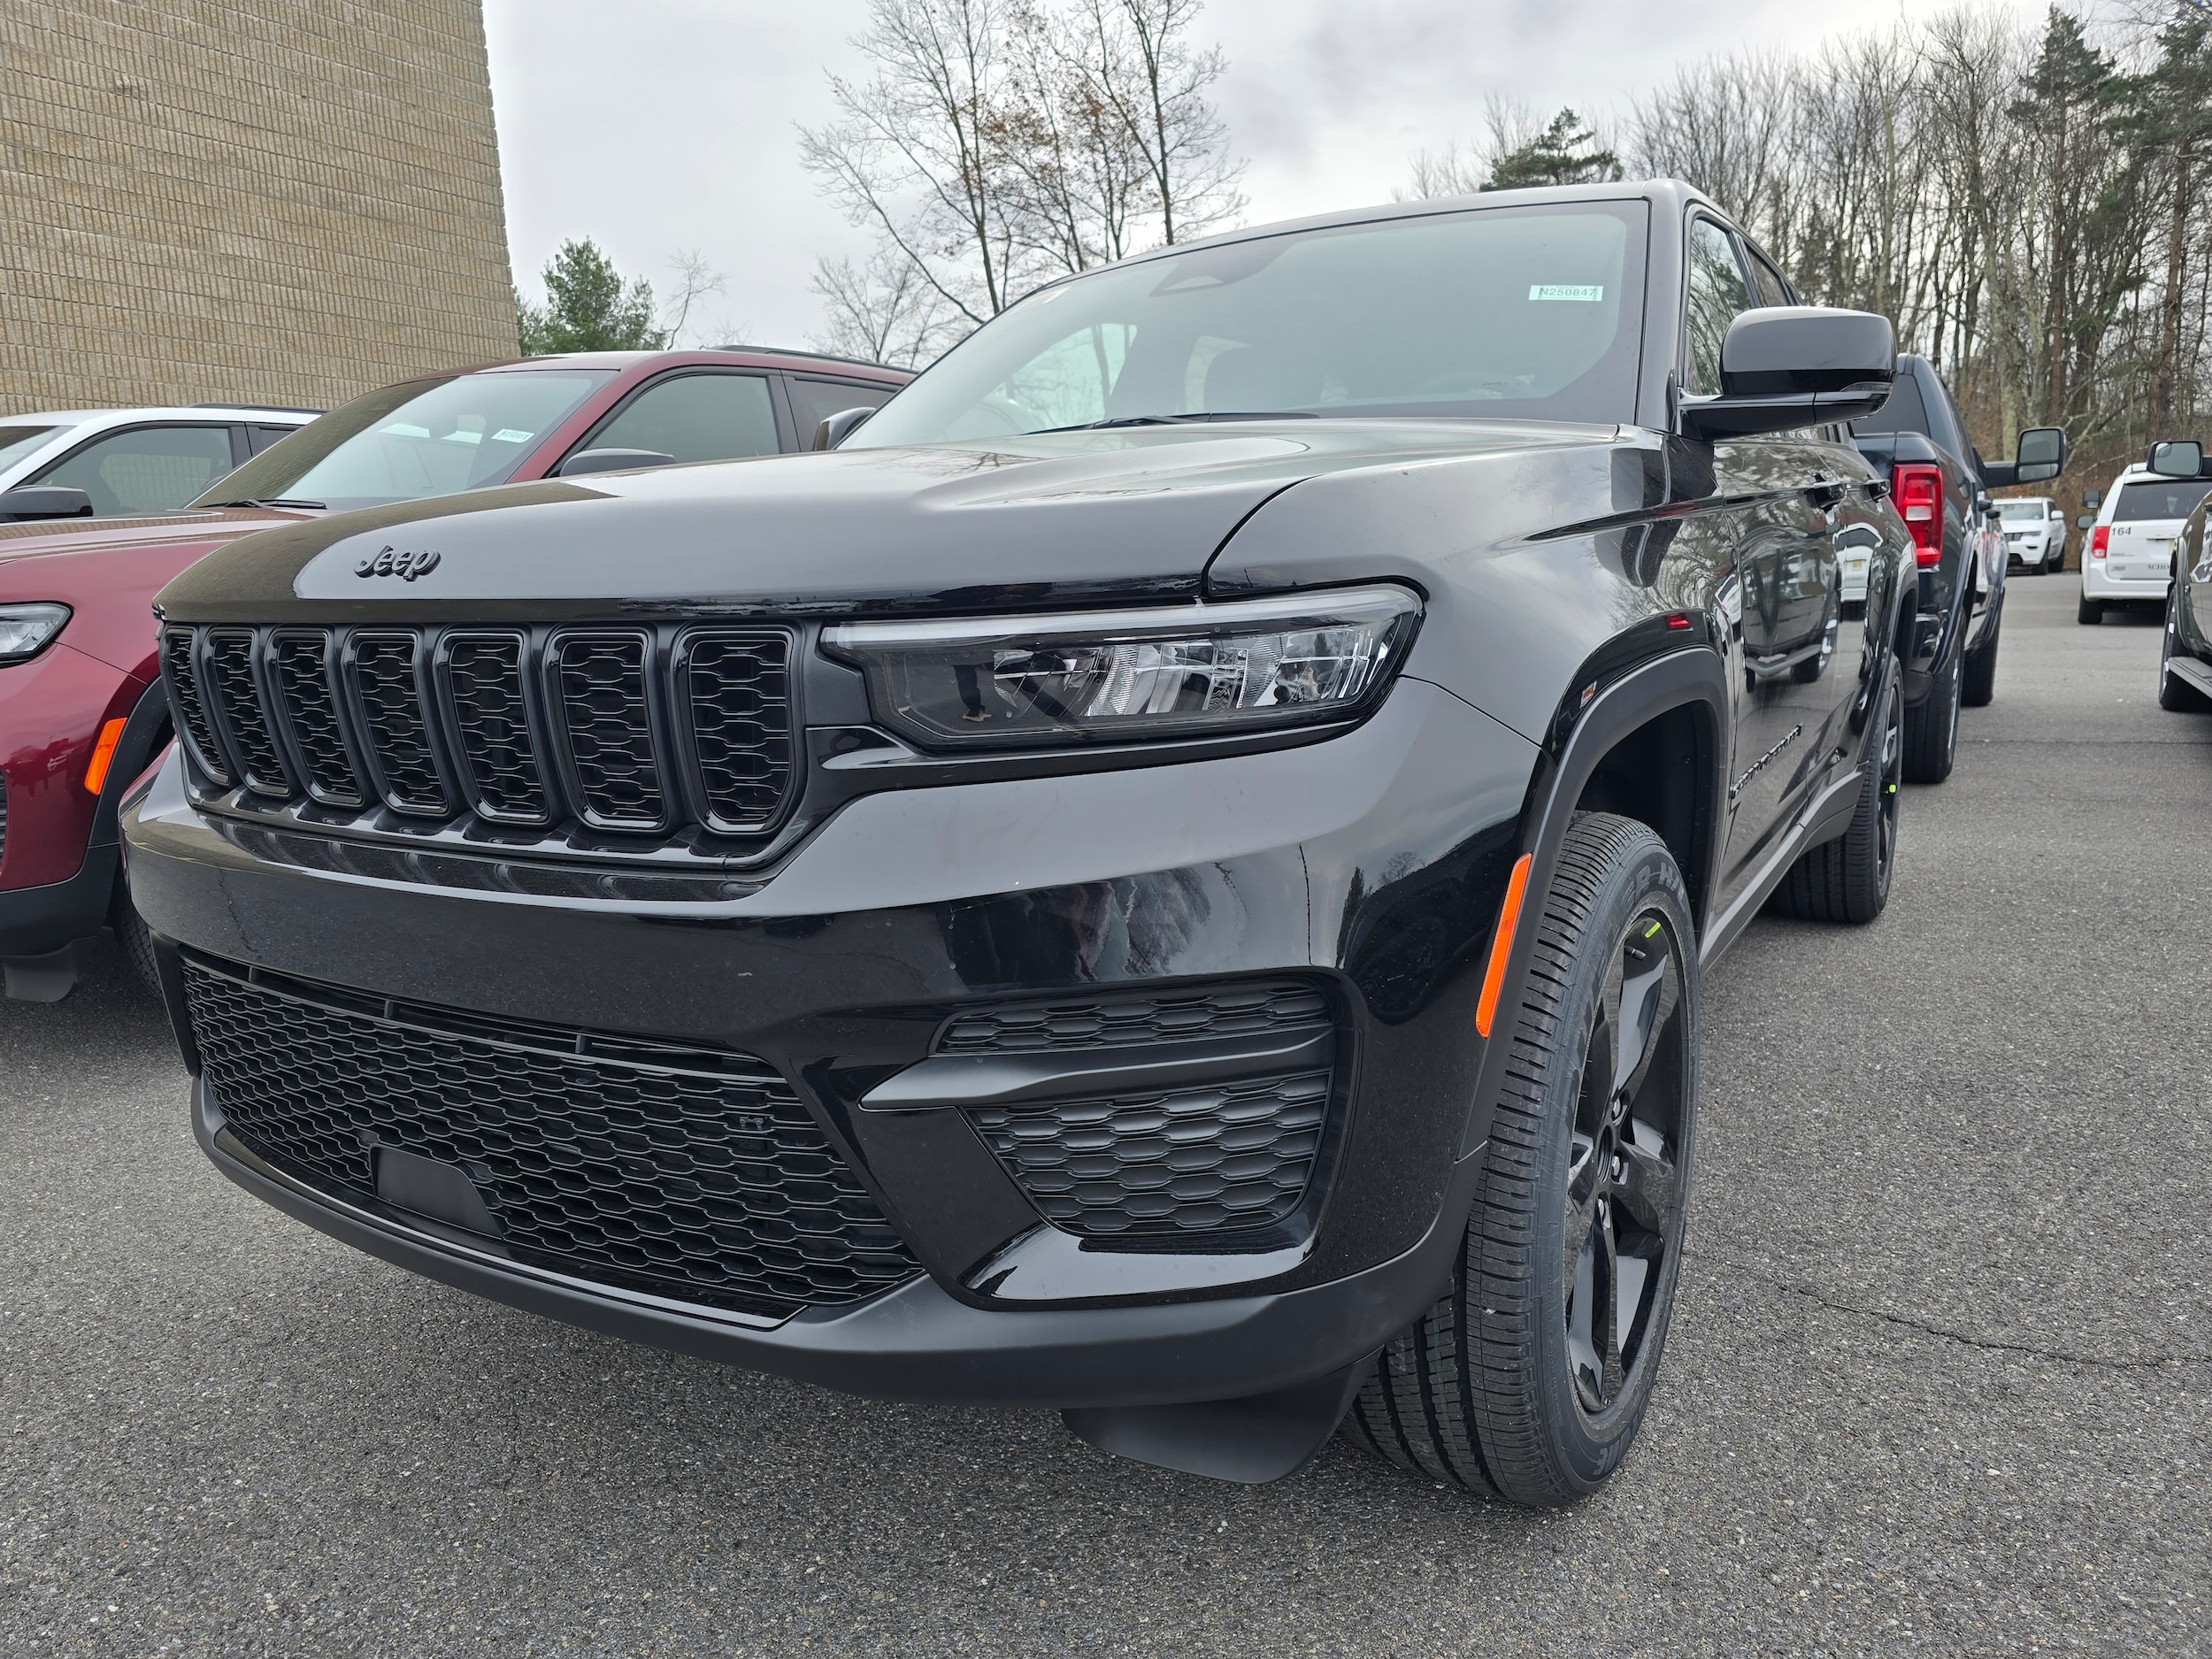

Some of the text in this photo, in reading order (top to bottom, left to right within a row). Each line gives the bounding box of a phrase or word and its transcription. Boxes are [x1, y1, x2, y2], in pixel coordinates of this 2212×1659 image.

[1540, 288, 1596, 296] N250847
[2112, 527, 2131, 536] 164
[354, 545, 441, 582] Jeep
